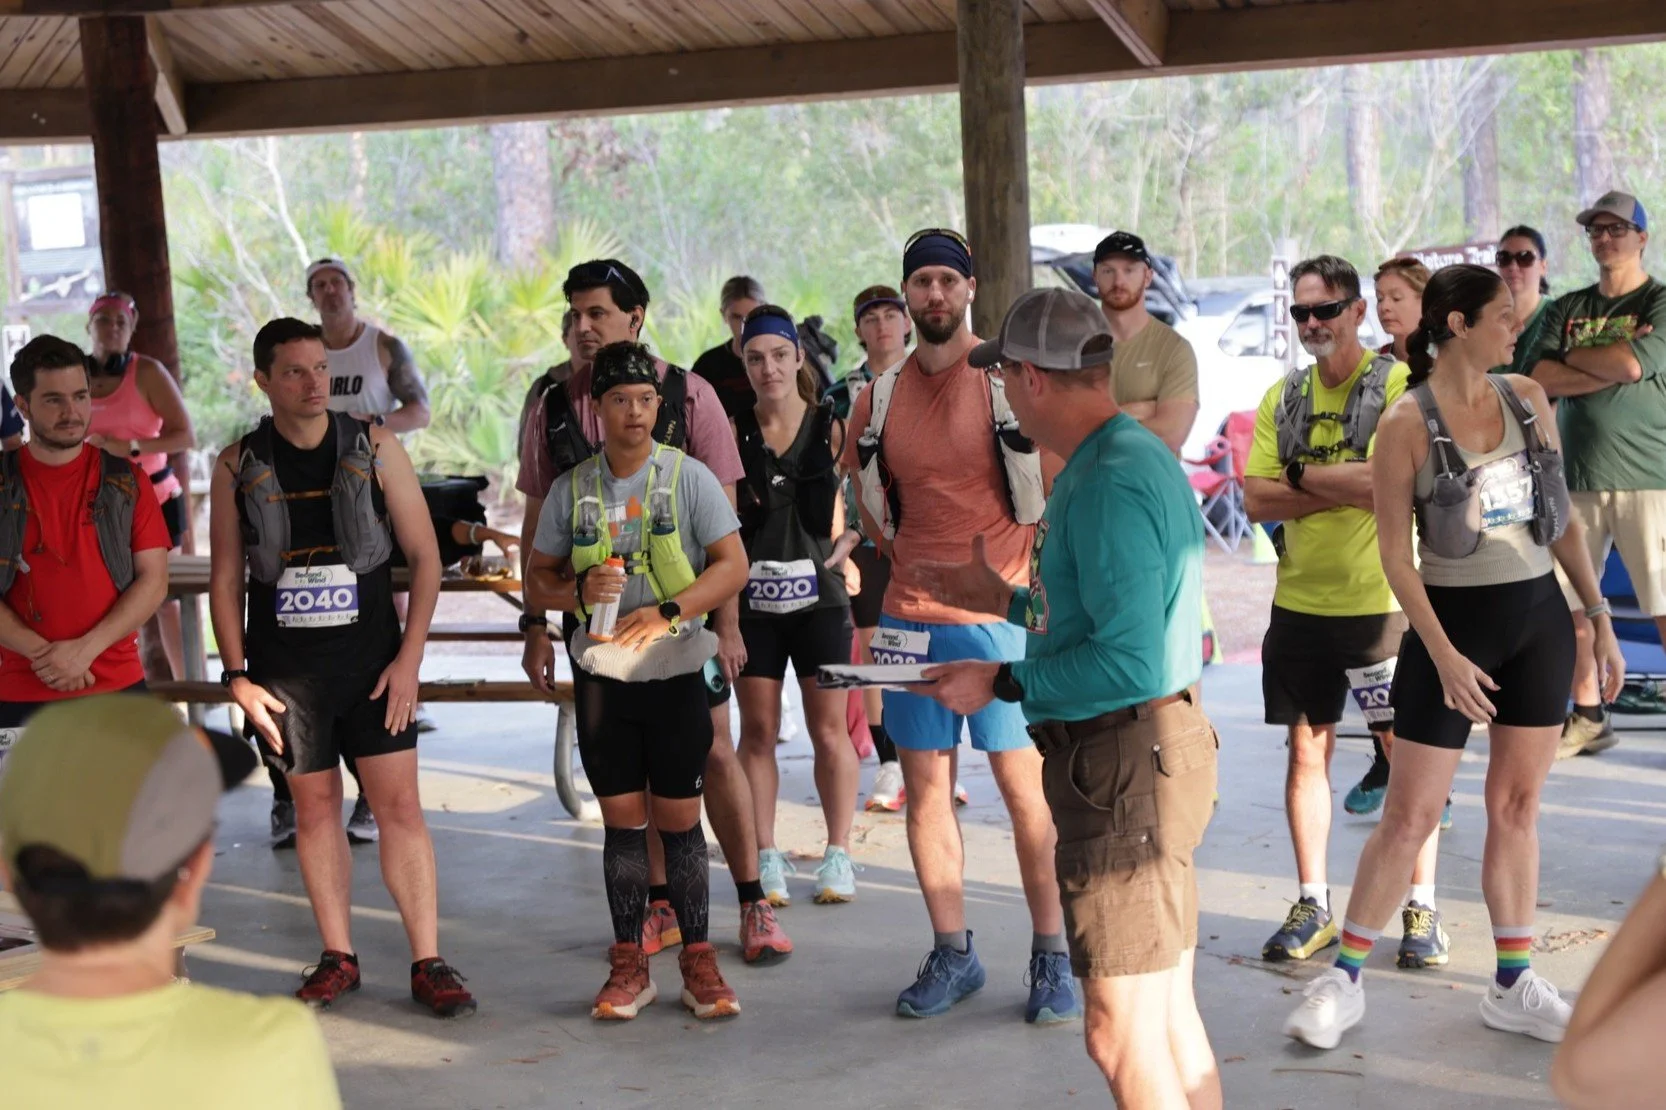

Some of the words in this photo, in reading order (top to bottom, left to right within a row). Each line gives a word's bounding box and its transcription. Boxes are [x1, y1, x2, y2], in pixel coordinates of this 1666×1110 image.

[330, 375, 363, 396] RLO
[750, 578, 812, 599] 2020
[280, 588, 353, 611] 2040
